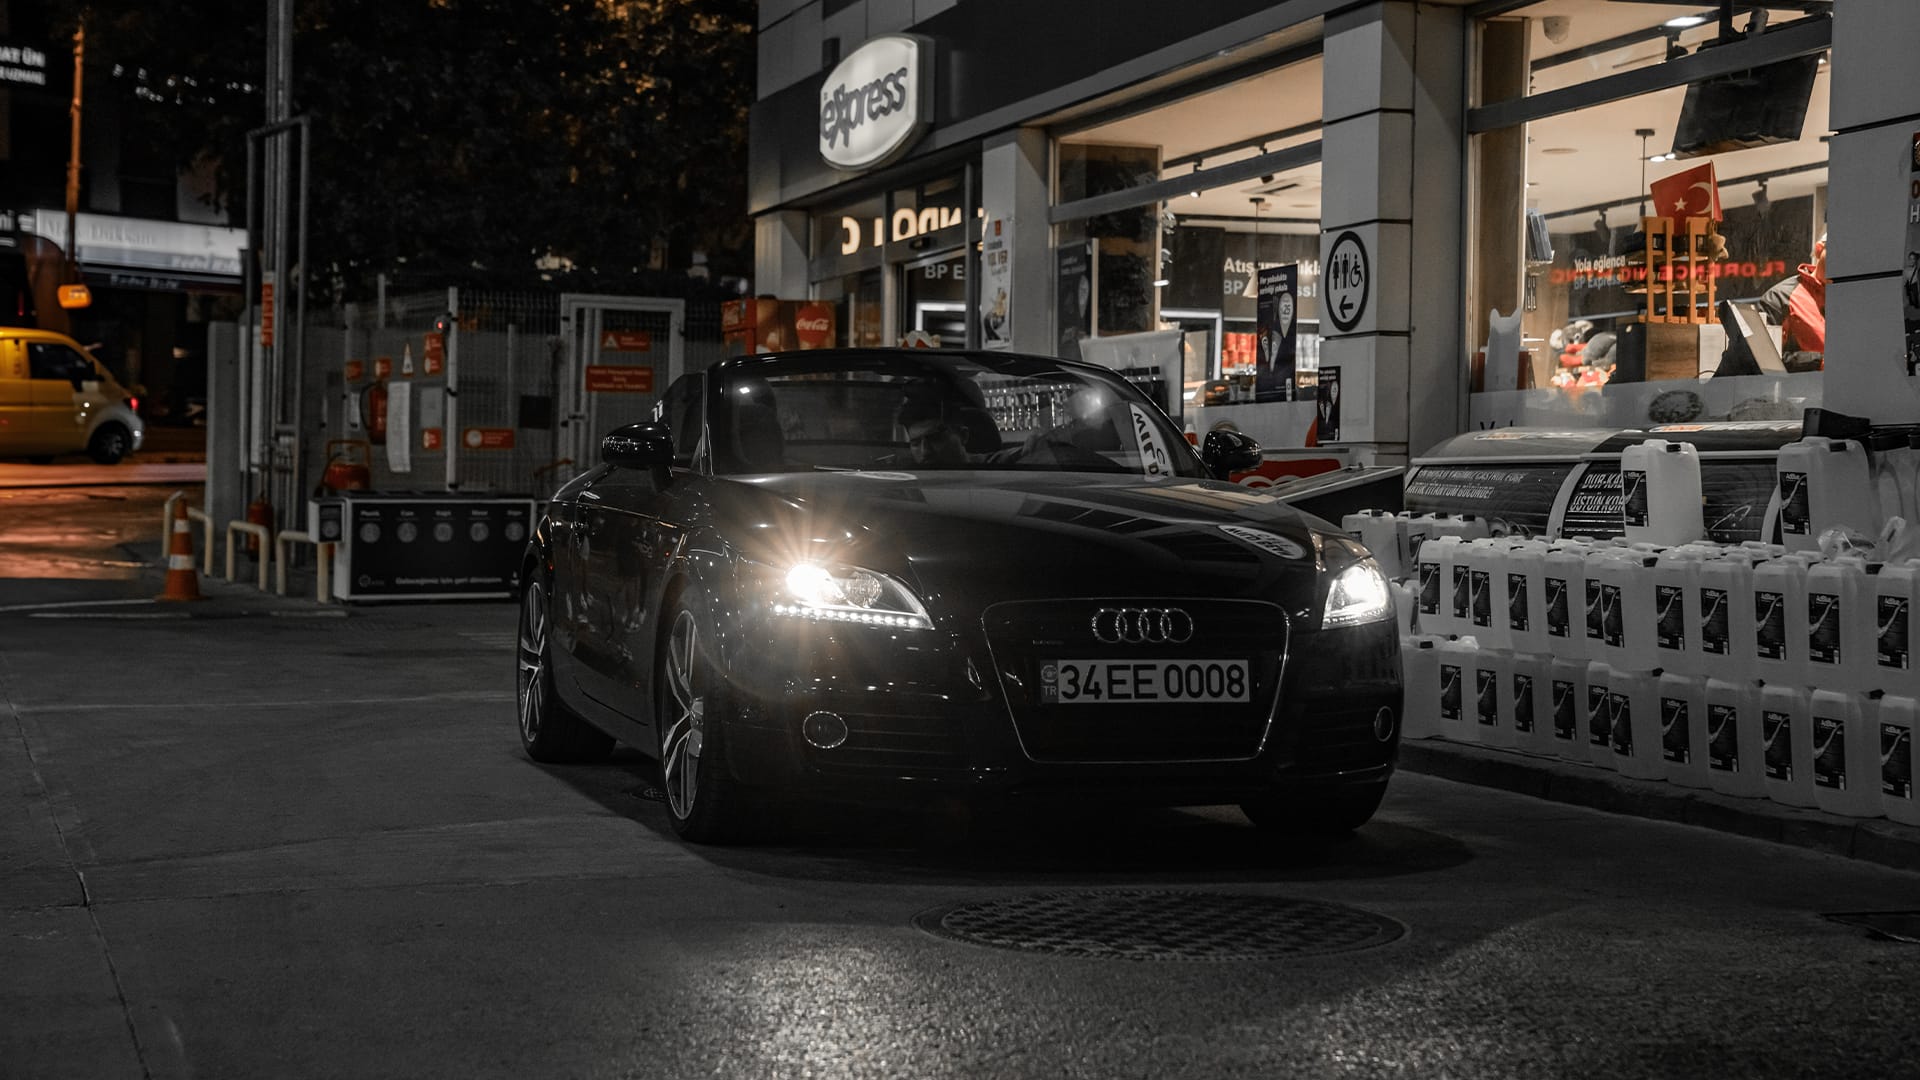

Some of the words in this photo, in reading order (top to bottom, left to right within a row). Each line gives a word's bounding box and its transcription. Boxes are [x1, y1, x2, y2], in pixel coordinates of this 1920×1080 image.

[925, 264, 948, 279] BP
[1224, 280, 1244, 295] BP
[1060, 664, 1102, 700] 34
[1106, 664, 1158, 700] EE
[1164, 664, 1245, 698] 0008
[1043, 685, 1057, 696] TR
